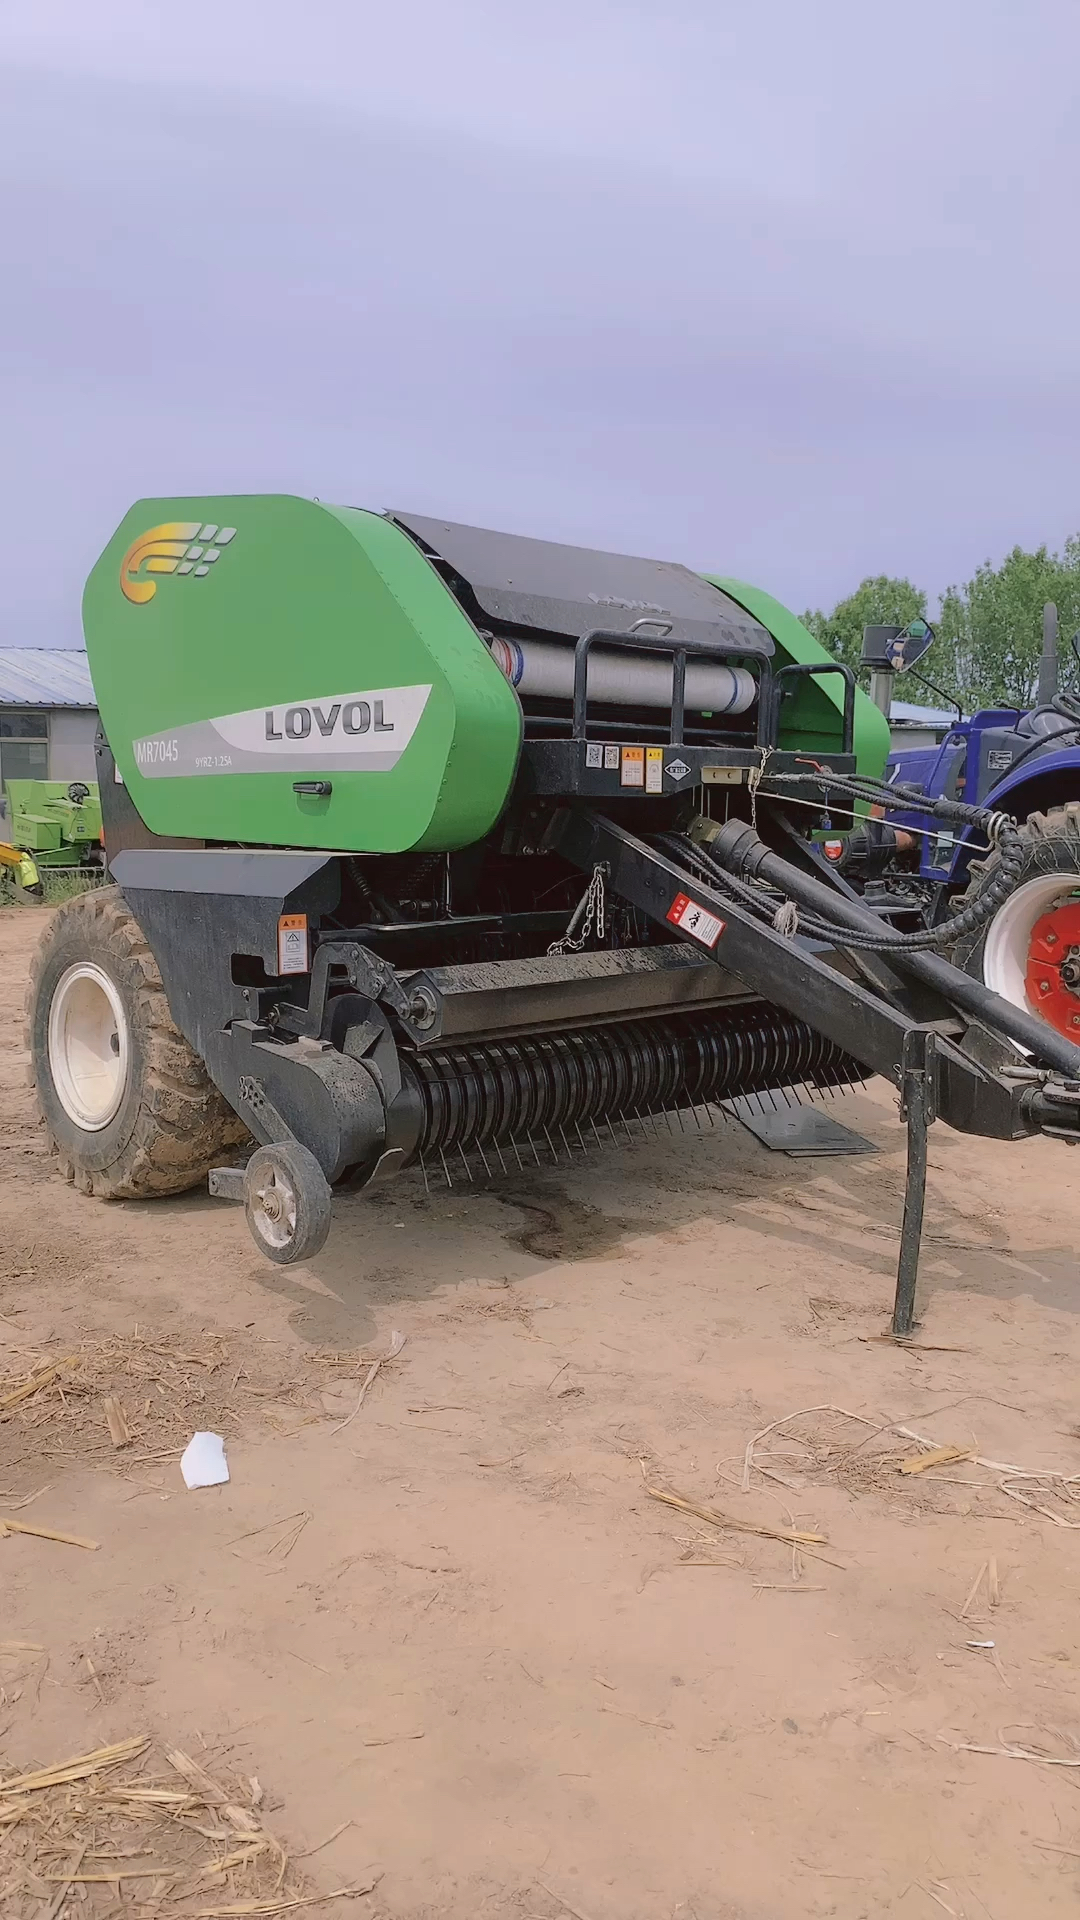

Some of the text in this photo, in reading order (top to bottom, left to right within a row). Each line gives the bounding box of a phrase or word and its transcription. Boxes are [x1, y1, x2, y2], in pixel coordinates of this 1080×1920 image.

[265, 700, 394, 740] LOVOL
[137, 740, 178, 763] MR7045
[195, 756, 232, 768] 9YRZ-1.25A
